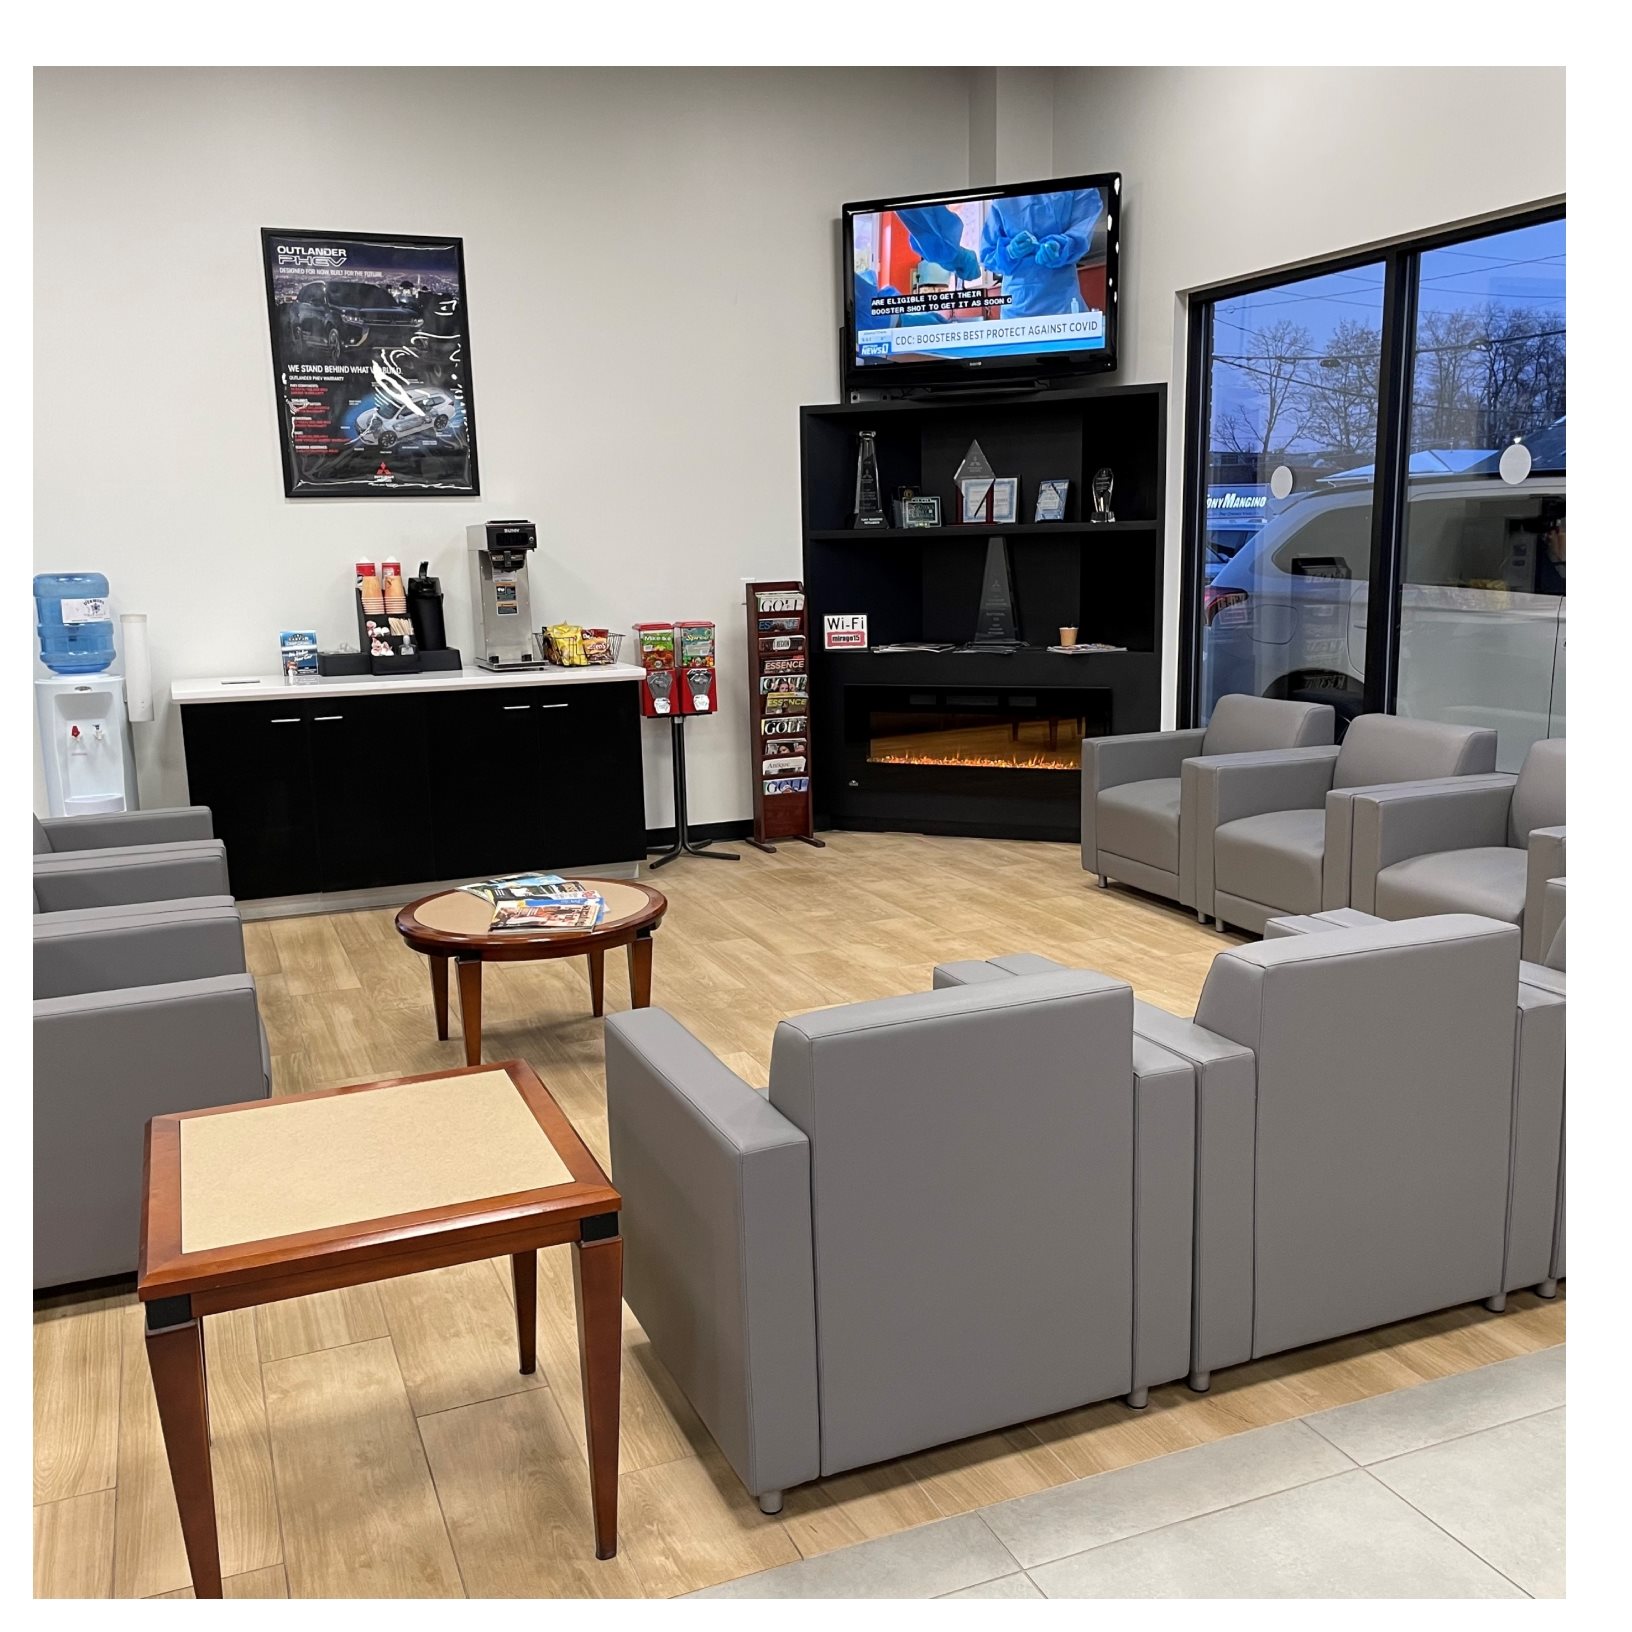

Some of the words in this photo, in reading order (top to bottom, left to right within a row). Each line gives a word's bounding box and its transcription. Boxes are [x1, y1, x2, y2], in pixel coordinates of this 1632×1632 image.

[277, 245, 347, 257] OUTLANDER
[278, 255, 348, 267] PHEV
[887, 295, 925, 305] ELIGIBLE
[957, 290, 982, 298] THEIR
[871, 307, 905, 315] BOOSTER
[906, 305, 926, 313] SHOT
[895, 336, 915, 346] CDC:
[917, 332, 961, 344] BOOSTERS
[963, 330, 985, 341] BEST
[986, 326, 1025, 338] PROTECT
[1028, 323, 1066, 335] AGAINST
[1069, 321, 1098, 332] COVID
[288, 365, 299, 373] WE
[301, 365, 323, 373] STAND
[325, 365, 349, 374] BEHIND
[350, 366, 369, 374] WHAT
[827, 617, 864, 630] Wi-Fi
[765, 661, 804, 670] ESSENCE
